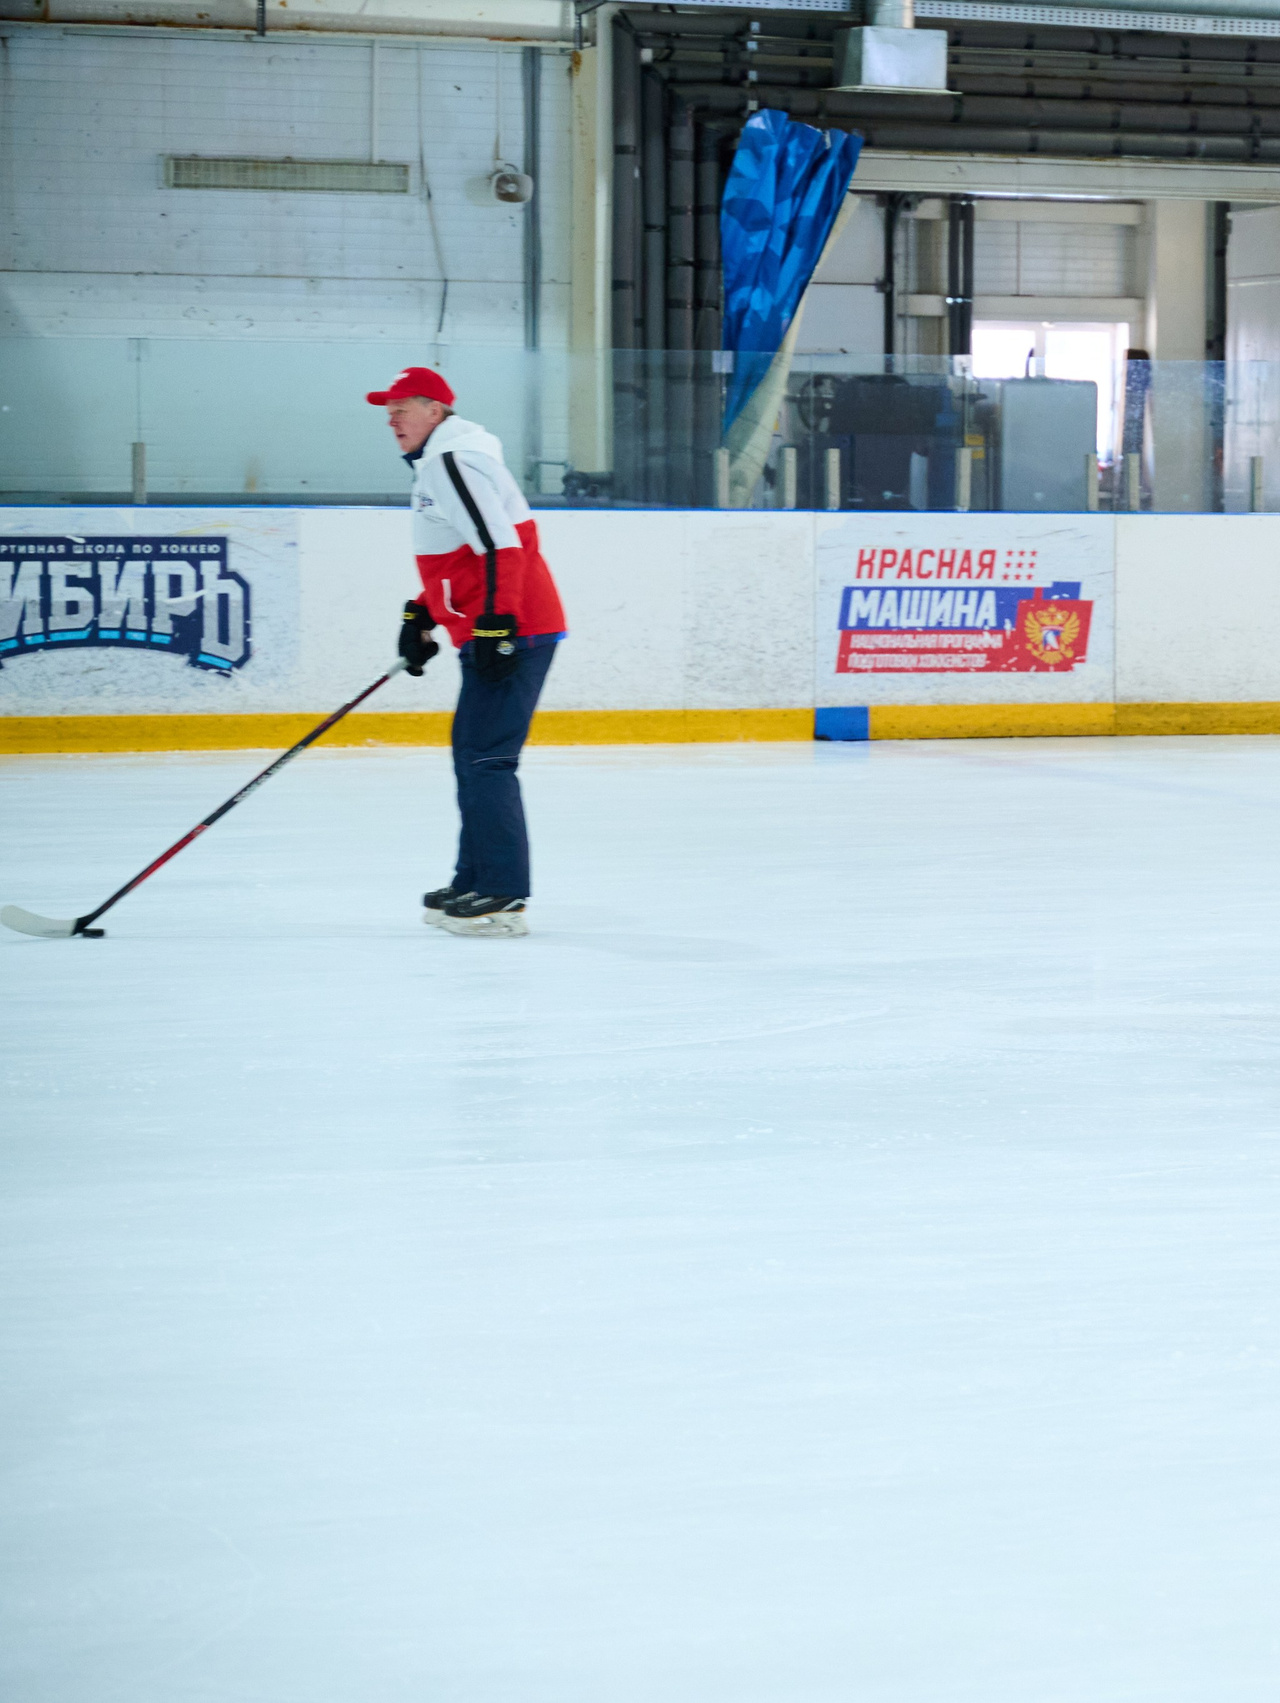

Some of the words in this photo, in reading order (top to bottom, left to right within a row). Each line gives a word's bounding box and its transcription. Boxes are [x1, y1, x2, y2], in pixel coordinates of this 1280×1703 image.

[72, 544, 126, 554] ШКОЛА
[132, 544, 153, 554] ПО
[160, 544, 221, 554] ХОККЕЮ
[856, 548, 997, 579] КРАСНАЯ
[847, 589, 998, 627] МАШИНА
